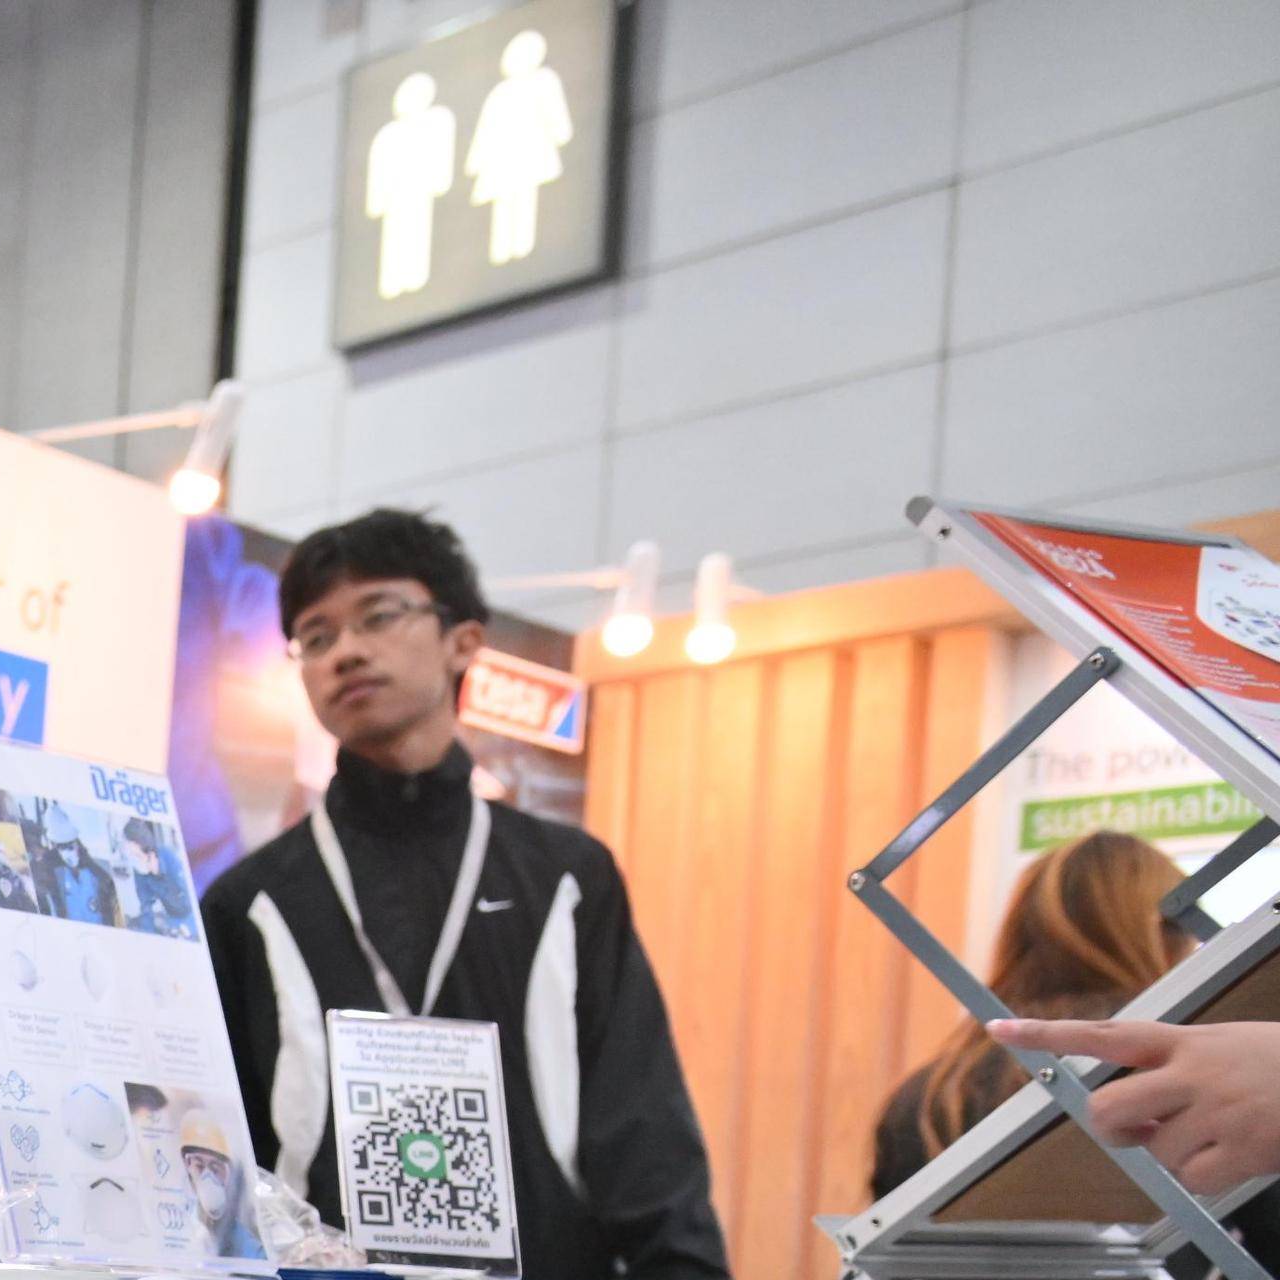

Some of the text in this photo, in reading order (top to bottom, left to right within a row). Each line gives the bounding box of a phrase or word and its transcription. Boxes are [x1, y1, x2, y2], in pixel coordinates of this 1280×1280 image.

[20, 580, 72, 637] of
[90, 765, 167, 818] Dräger
[1027, 748, 1092, 787] The
